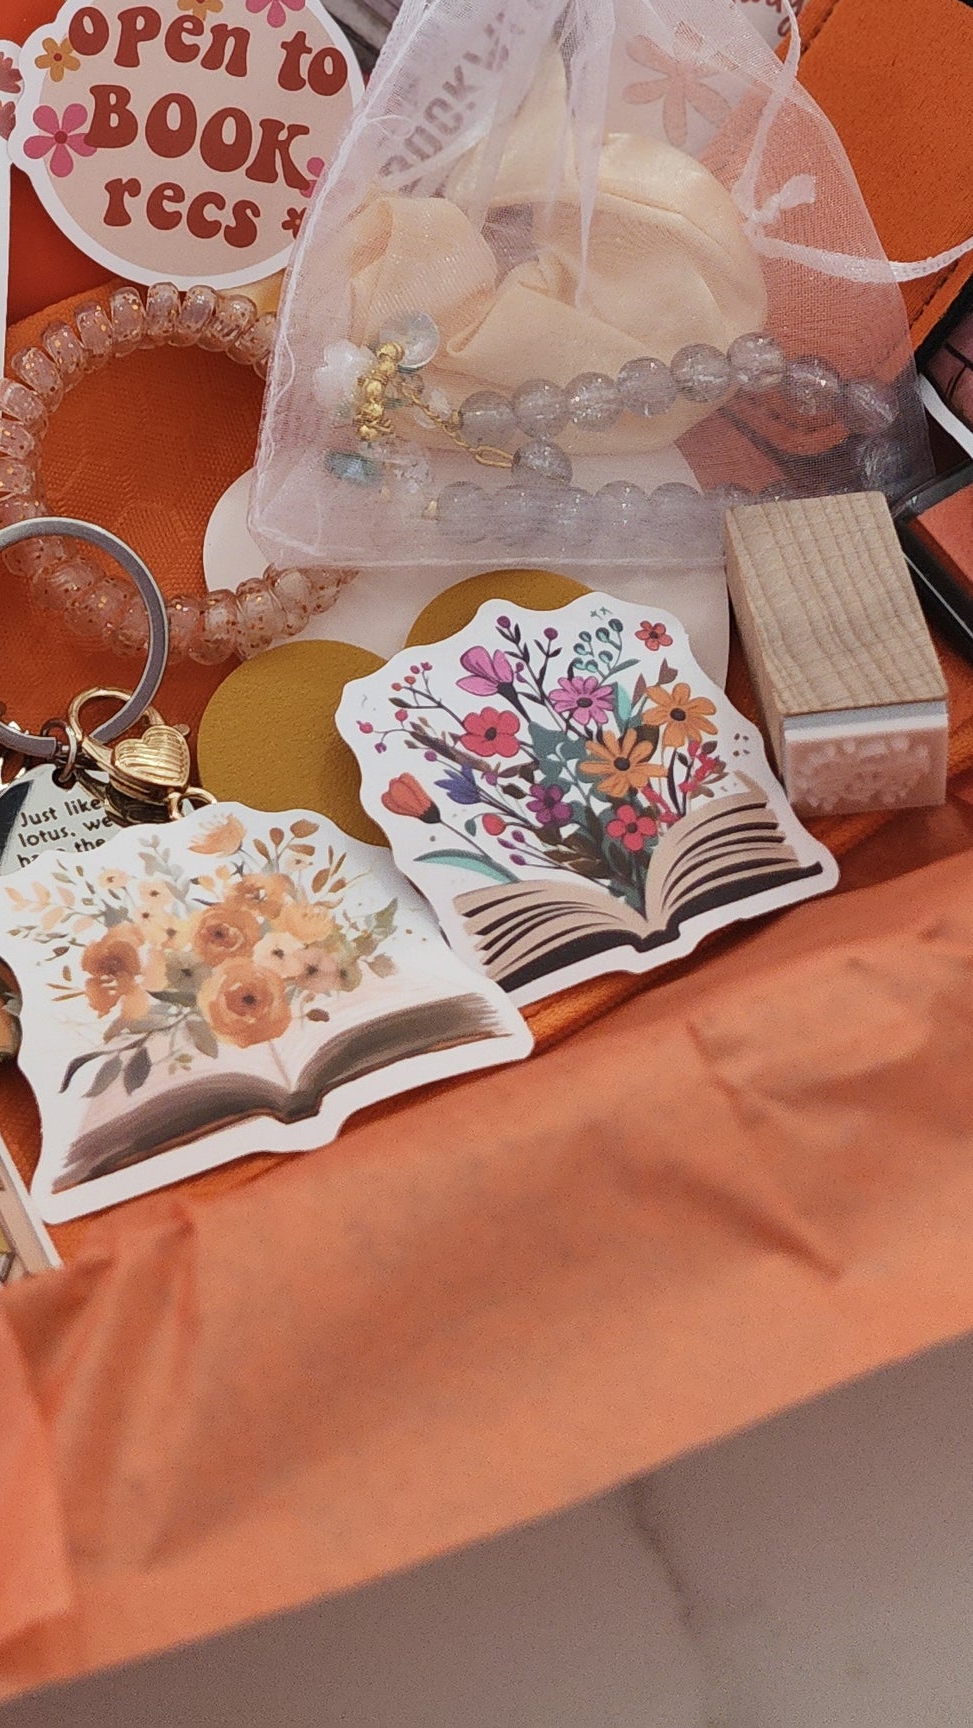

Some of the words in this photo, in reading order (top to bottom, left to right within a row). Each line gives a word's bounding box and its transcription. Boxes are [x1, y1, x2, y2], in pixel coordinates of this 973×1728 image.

[278, 31, 348, 96] to
[83, 84, 310, 190] BOOK
[103, 177, 261, 249] recs
[20, 807, 58, 828] Just
[64, 798, 102, 816] like
[82, 816, 114, 832] we
